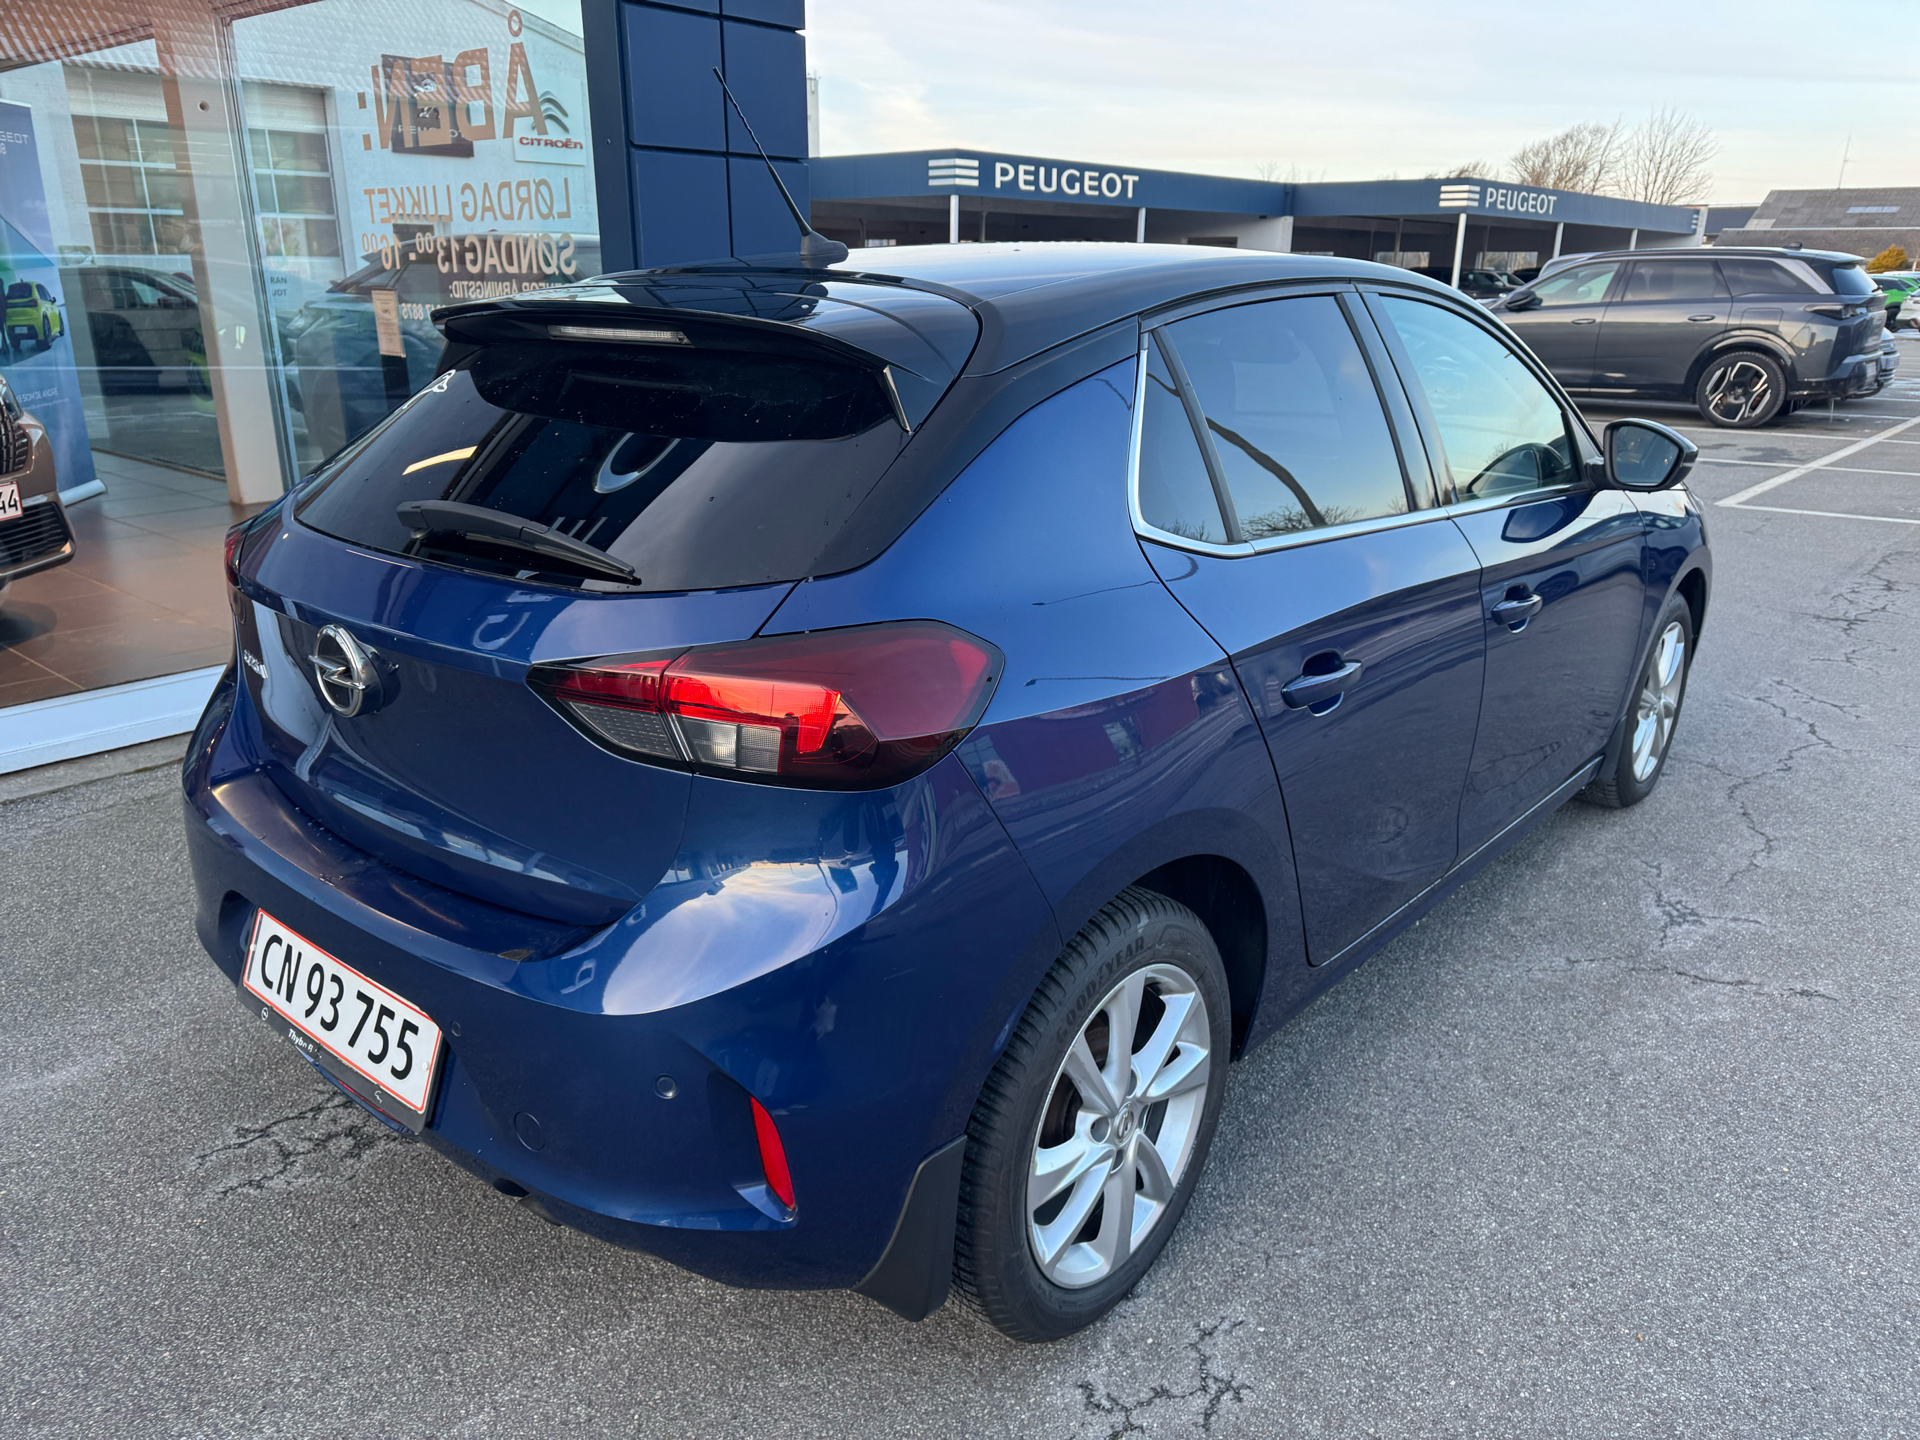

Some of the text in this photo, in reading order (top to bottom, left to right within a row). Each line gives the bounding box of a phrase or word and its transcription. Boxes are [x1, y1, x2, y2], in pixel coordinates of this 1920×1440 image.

[995, 162, 1139, 199] PEUGEOT
[1485, 187, 1557, 215] PEUGEOT
[261, 934, 419, 1080] CN 93 755
